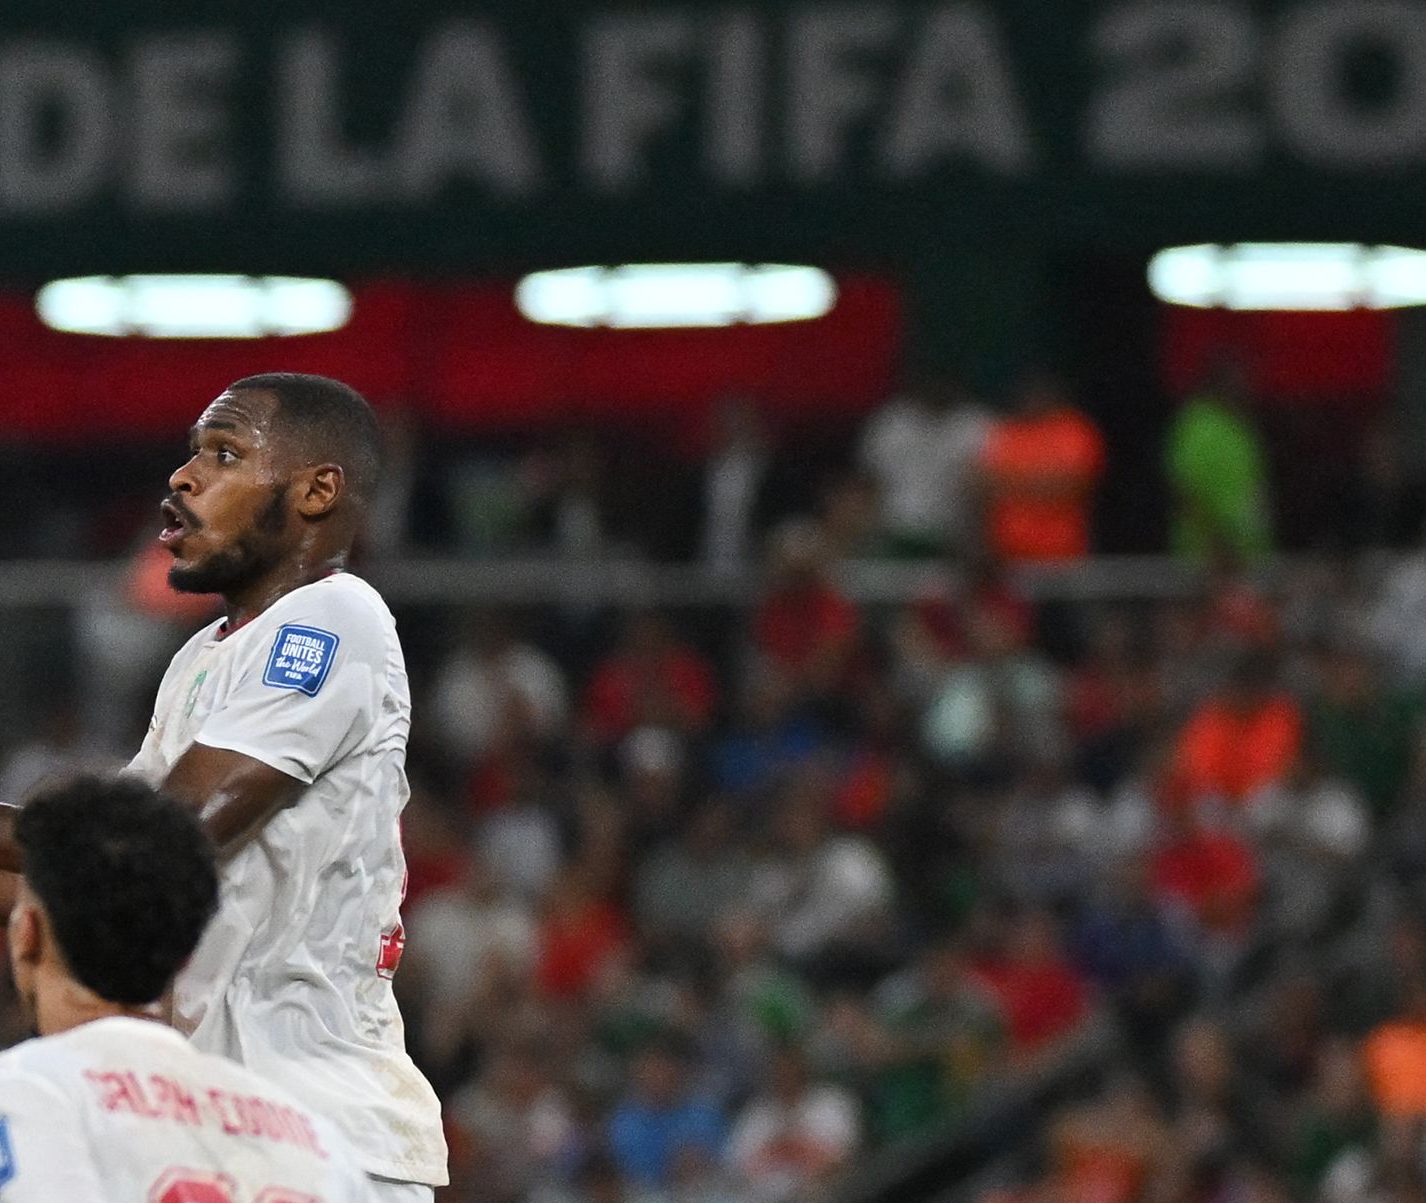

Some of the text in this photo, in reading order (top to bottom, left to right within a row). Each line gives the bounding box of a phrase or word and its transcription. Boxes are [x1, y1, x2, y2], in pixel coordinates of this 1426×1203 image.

[278, 20, 540, 204] LA
[580, 5, 1032, 188] FIFA
[285, 633, 325, 651] FOOTBALL
[281, 643, 323, 664] UNITES
[291, 658, 322, 677] World
